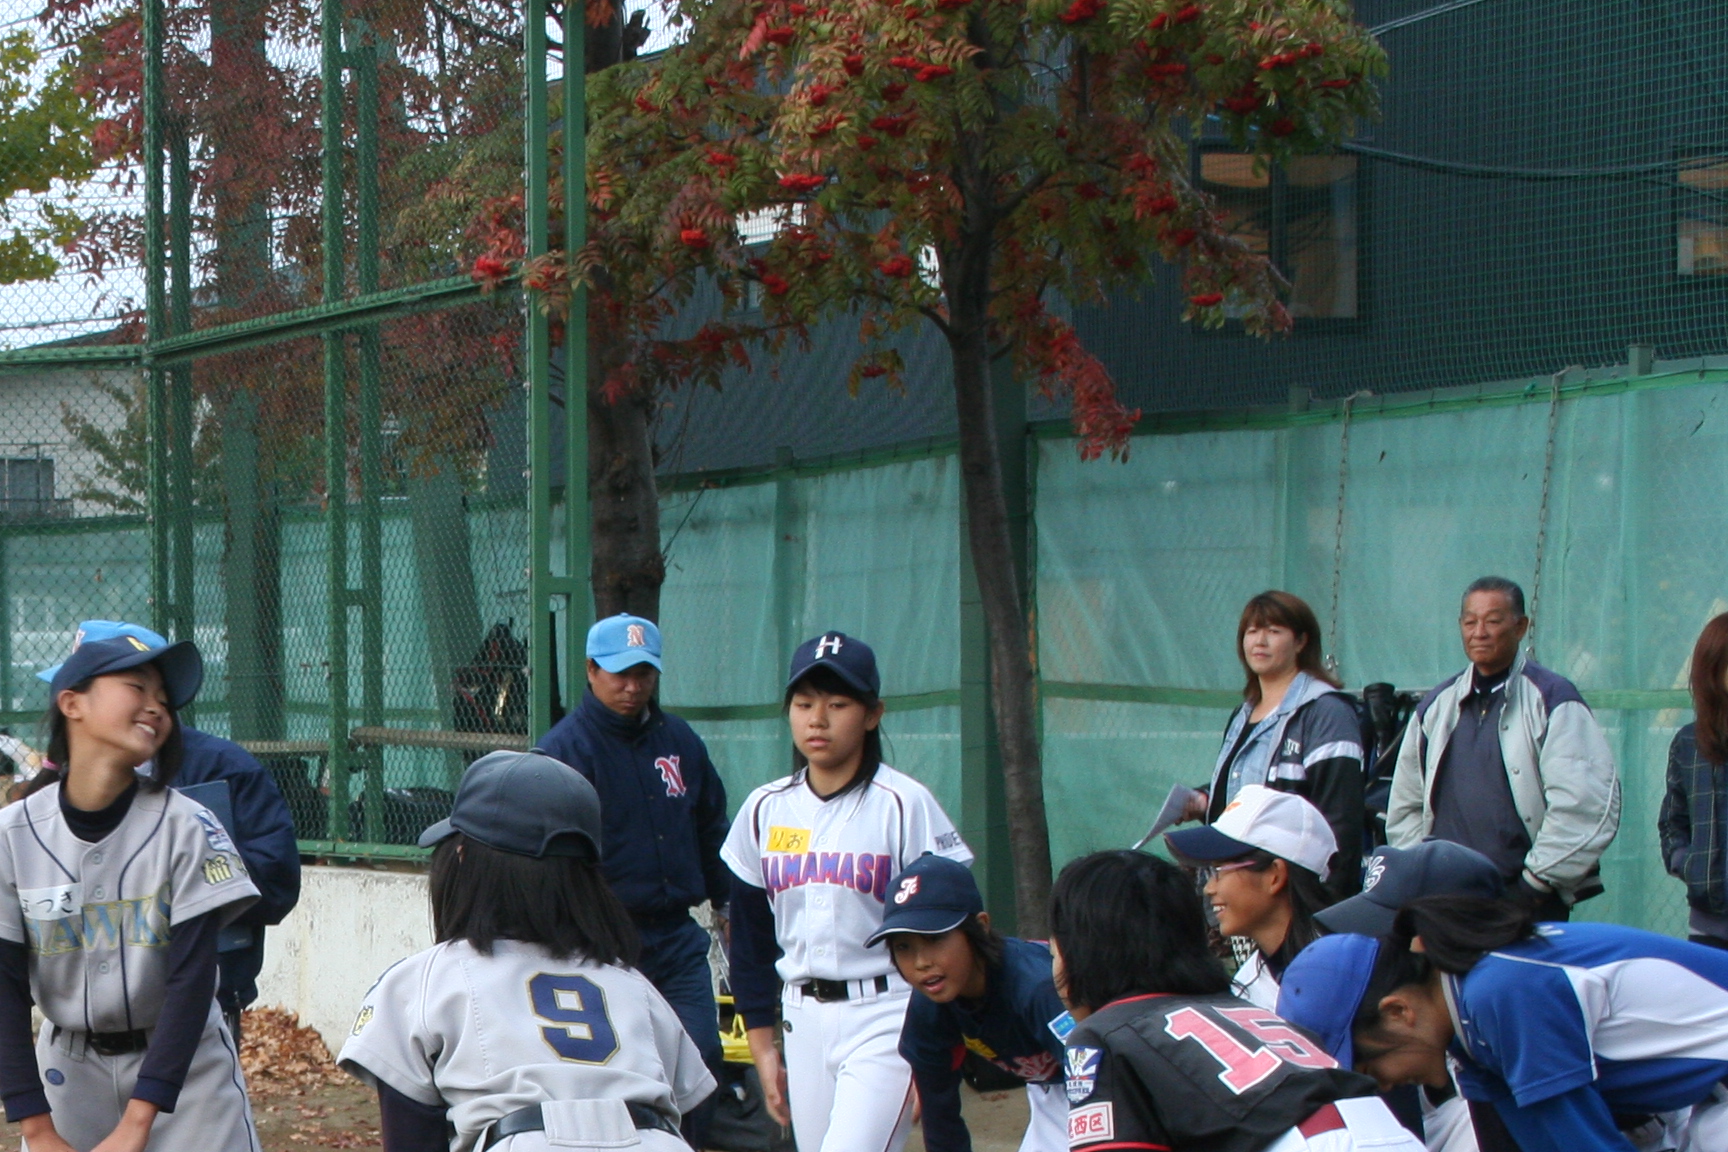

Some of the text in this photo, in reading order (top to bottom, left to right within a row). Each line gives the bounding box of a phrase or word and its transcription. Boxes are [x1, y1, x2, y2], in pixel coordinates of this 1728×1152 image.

[627, 624, 645, 647] N
[815, 635, 843, 660] H
[654, 754, 687, 797] N
[525, 971, 621, 1066] 9
[1164, 1005, 1340, 1095] 15
